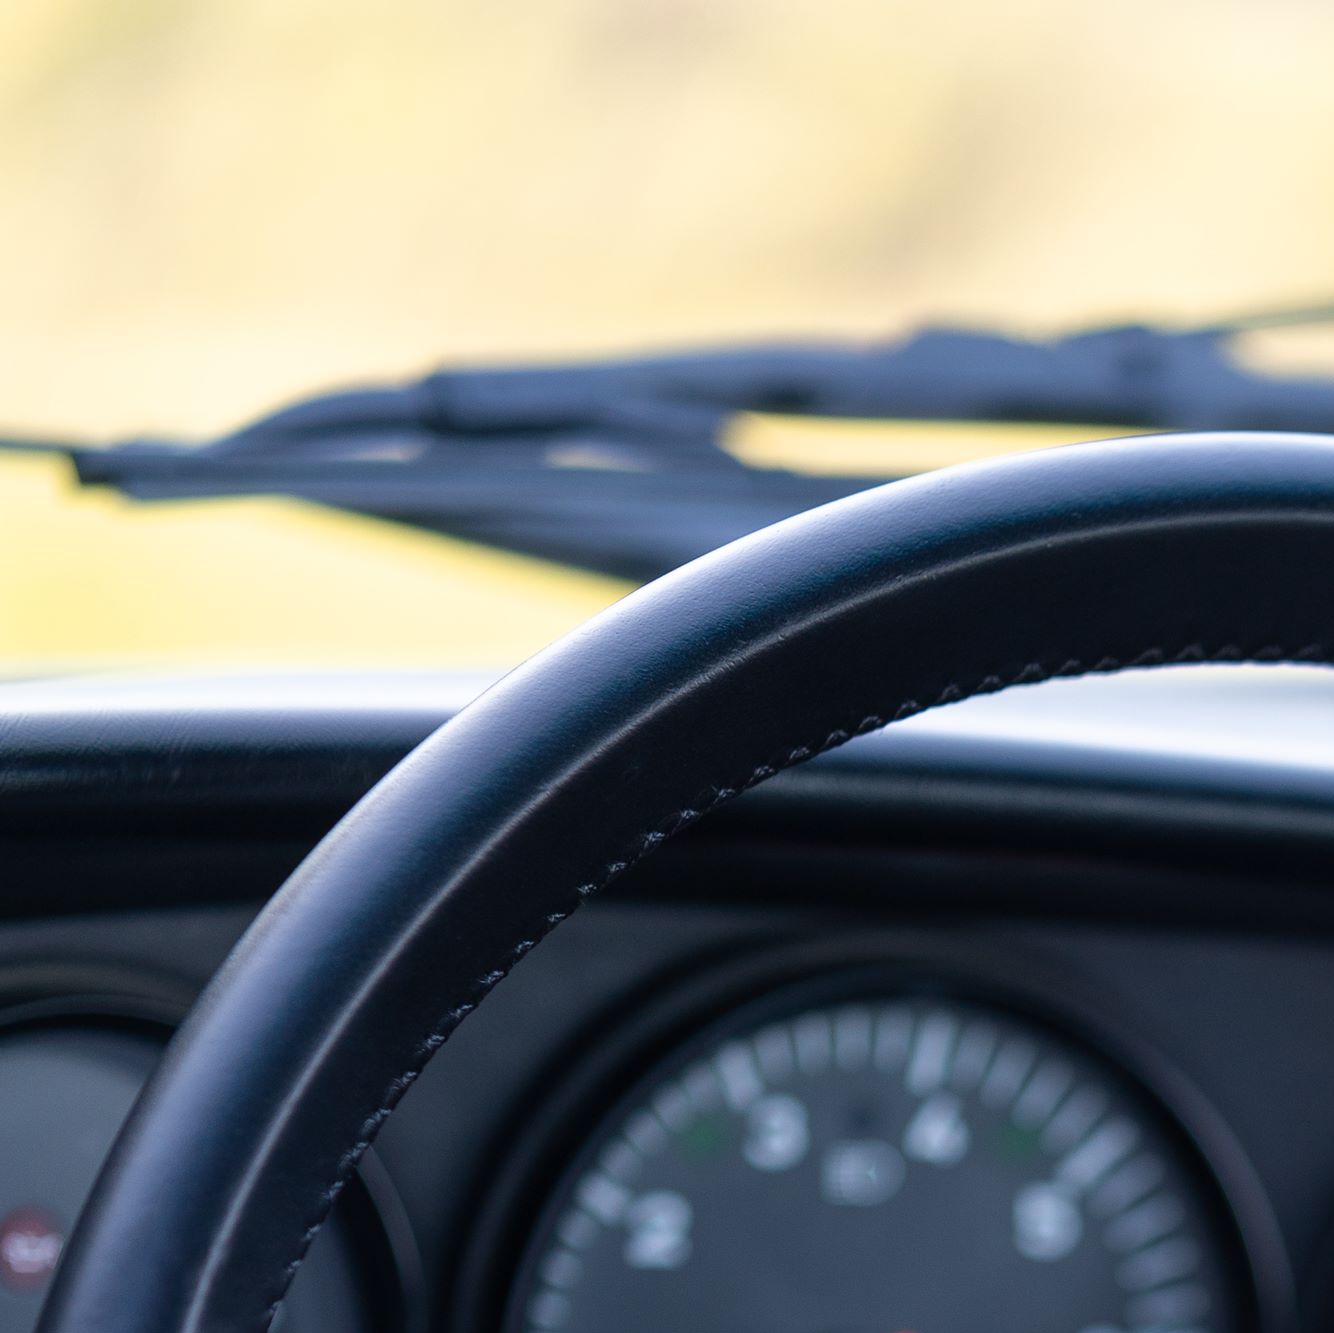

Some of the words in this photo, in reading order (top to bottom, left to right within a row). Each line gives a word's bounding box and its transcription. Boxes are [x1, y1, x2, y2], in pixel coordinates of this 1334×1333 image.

[743, 1095, 809, 1171] 3
[903, 1095, 970, 1167] 4
[626, 1191, 693, 1268] 2
